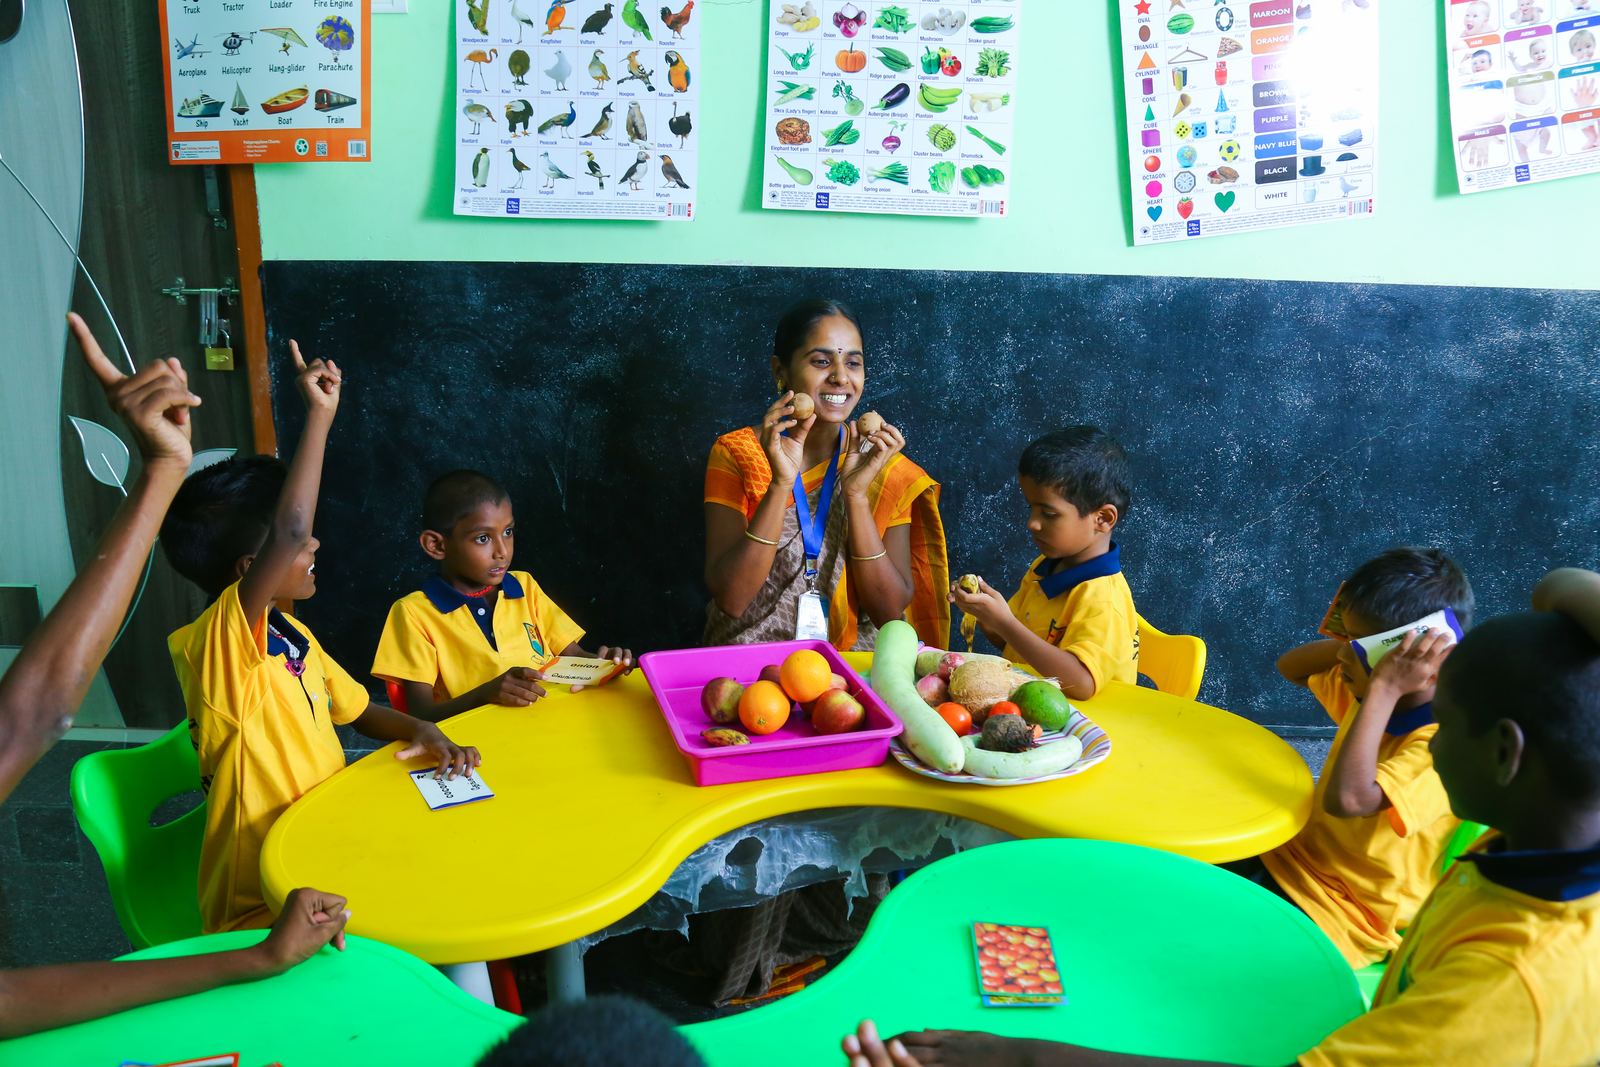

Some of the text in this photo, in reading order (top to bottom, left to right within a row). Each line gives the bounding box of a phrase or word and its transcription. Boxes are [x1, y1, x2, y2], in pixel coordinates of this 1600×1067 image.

[270, 0, 292, 9] Loader
[184, 6, 200, 14] Truck
[1253, 8, 1291, 18] MAROON
[269, 64, 306, 73] Hang-glider
[278, 117, 292, 125] Boat
[1261, 115, 1288, 124] PURPLE
[1255, 139, 1296, 150] NAVY BLUE
[1264, 166, 1288, 175] BLACK
[432, 777, 454, 799] coconu
